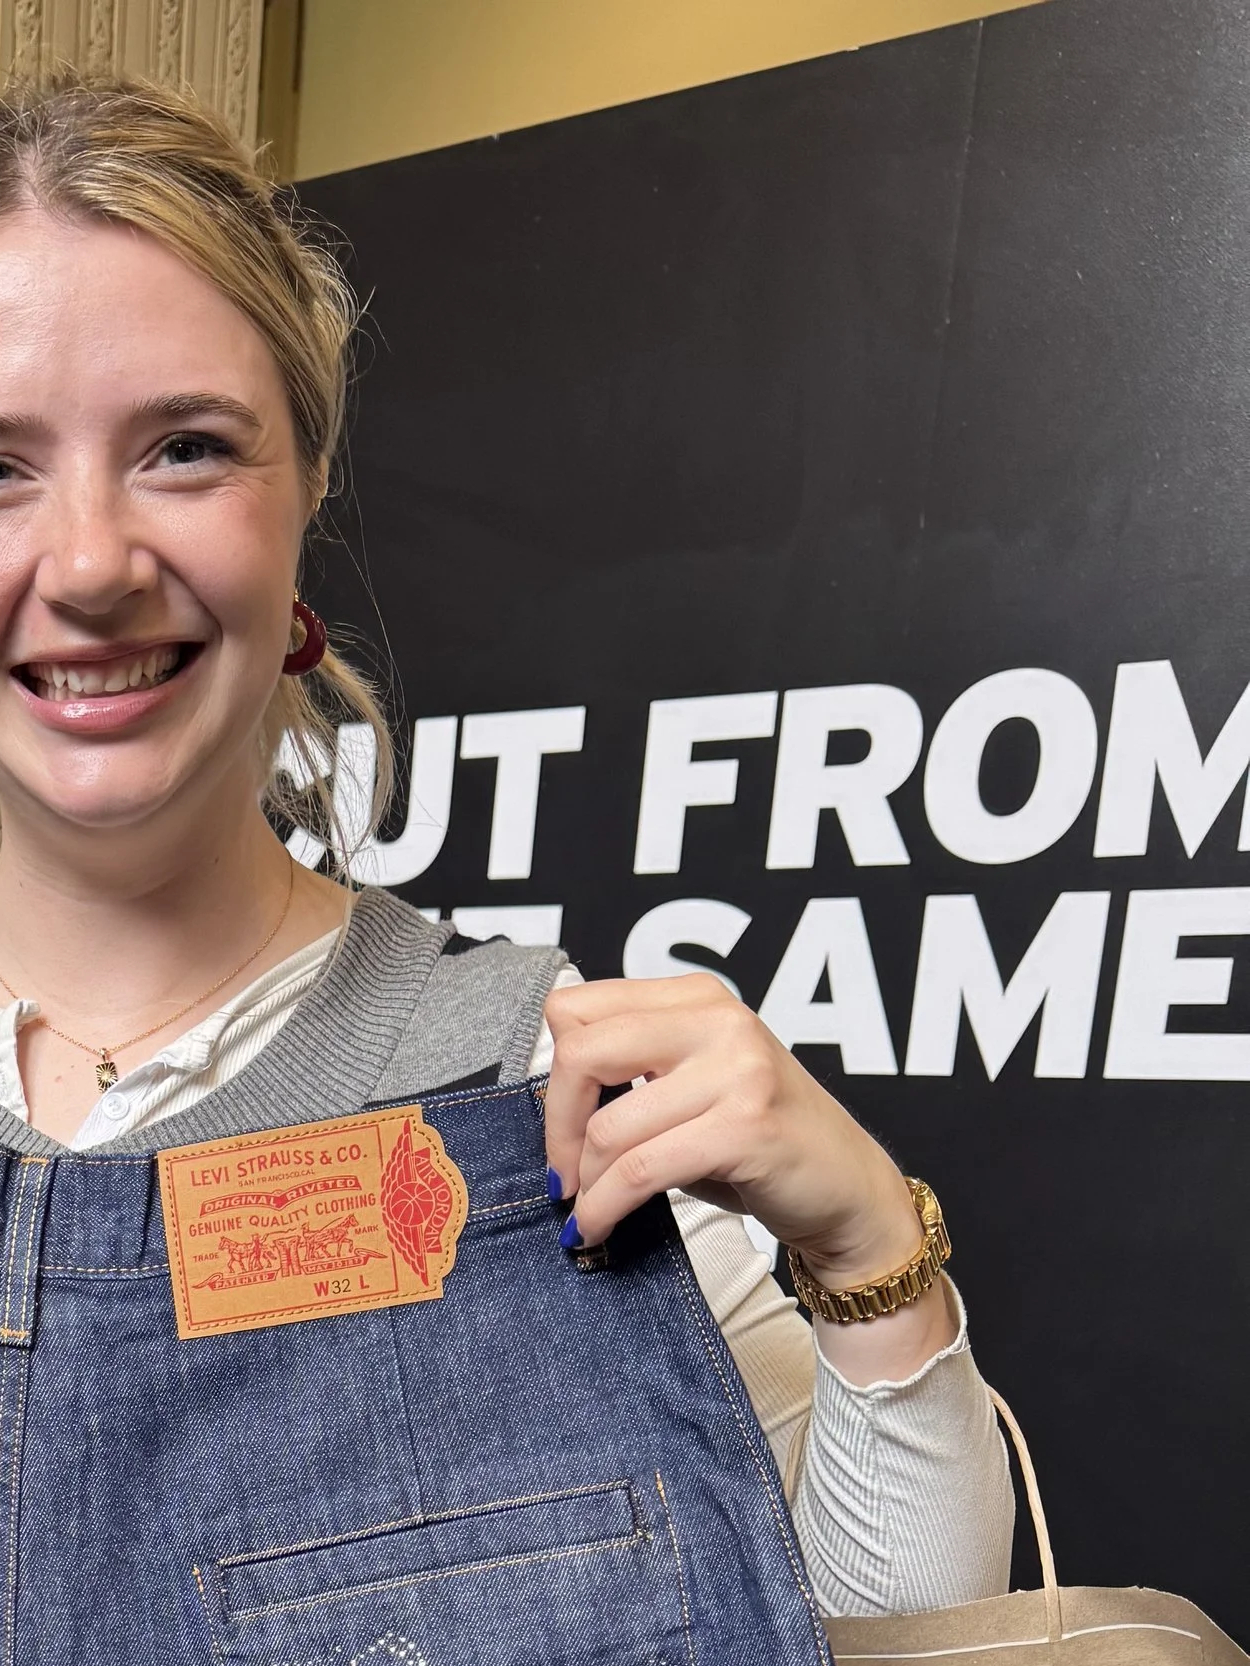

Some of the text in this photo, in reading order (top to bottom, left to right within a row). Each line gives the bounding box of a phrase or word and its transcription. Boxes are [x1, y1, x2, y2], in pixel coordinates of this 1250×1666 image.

[633, 659, 1250, 875] FROM
[190, 1143, 368, 1187] LEVI STRAUSS & CO.
[203, 1178, 357, 1213] ORIGINAL RIVETED
[238, 1179, 255, 1188] SAN
[189, 1192, 377, 1238] GENUINE QUALITY CLOTHING
[413, 1155, 451, 1250] AIR JORDAN
[354, 1224, 380, 1236] MARK
[192, 1252, 220, 1263] TRADE
[359, 1274, 370, 1290] L
